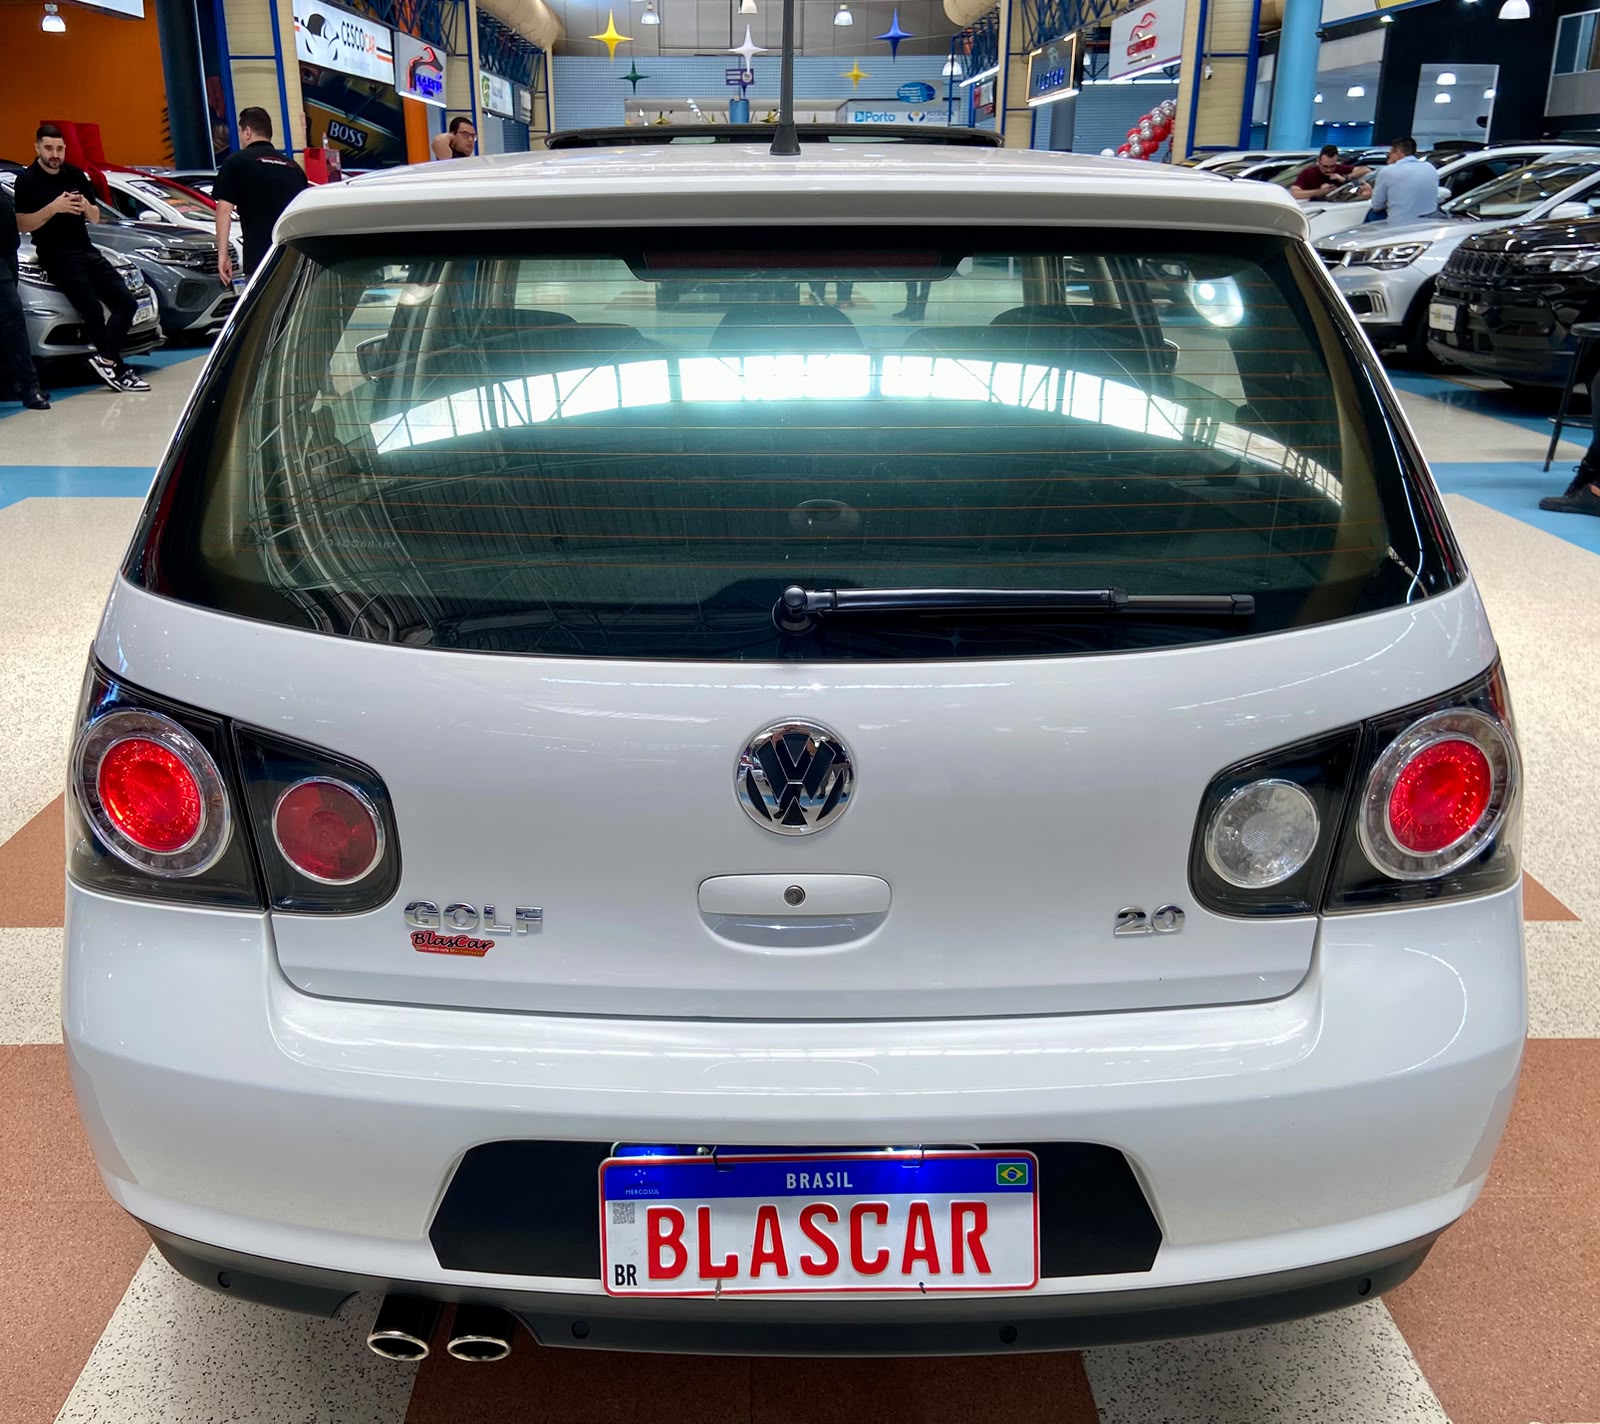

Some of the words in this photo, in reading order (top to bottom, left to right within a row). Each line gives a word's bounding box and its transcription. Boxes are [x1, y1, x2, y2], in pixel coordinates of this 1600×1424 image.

[865, 112, 896, 122] Porto
[329, 121, 366, 149] BOSS
[403, 899, 544, 935] GOLF
[1114, 903, 1186, 935] 2.0
[412, 932, 495, 950] BlasCar
[785, 1171, 854, 1190] BRASIL
[645, 1200, 993, 1281] BLASCAR
[614, 1264, 639, 1287] BR
